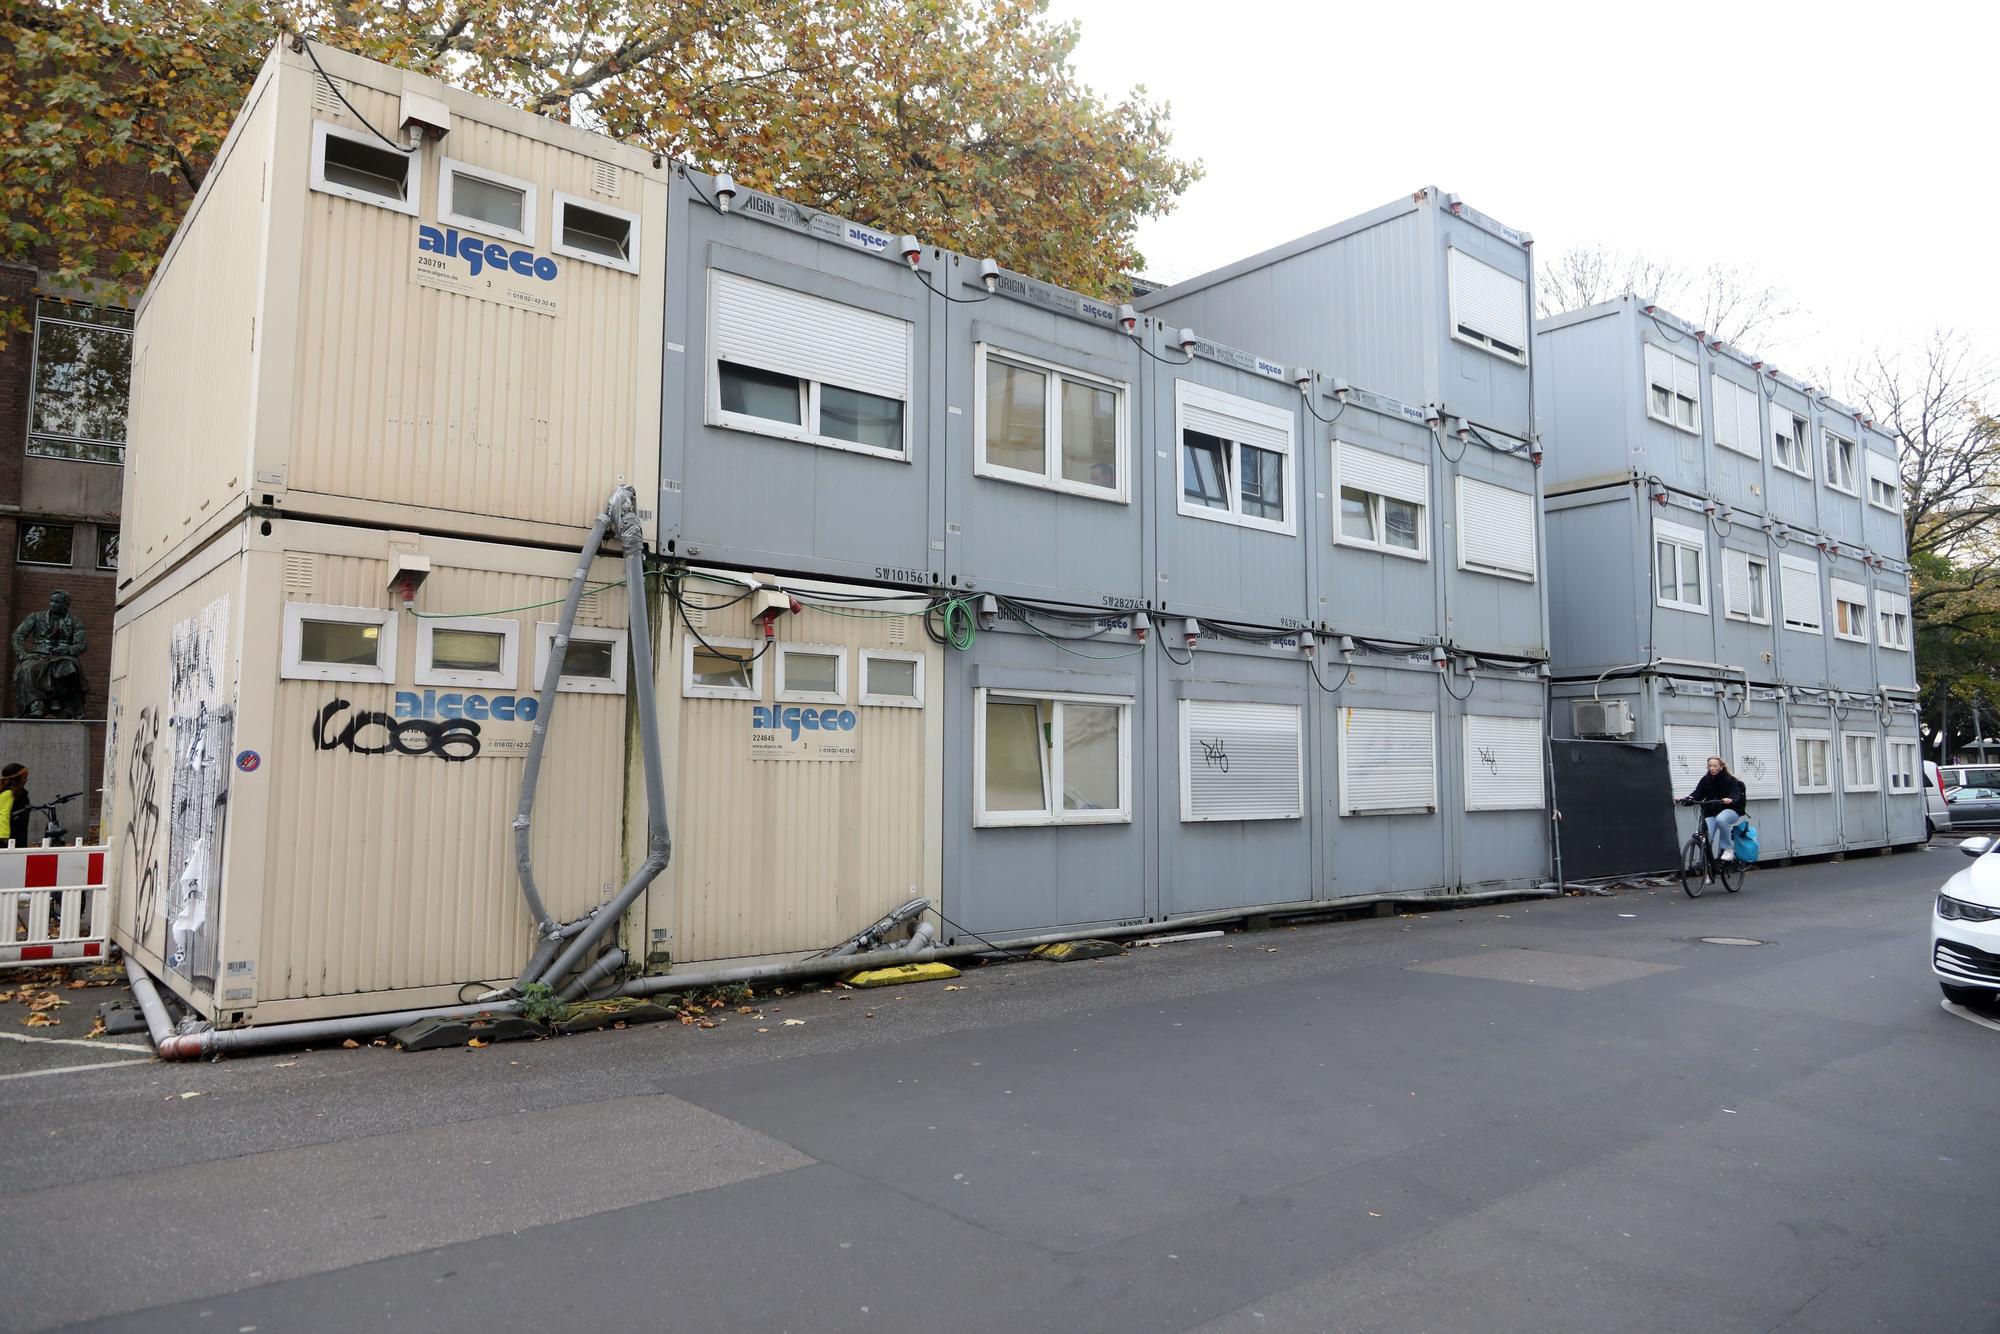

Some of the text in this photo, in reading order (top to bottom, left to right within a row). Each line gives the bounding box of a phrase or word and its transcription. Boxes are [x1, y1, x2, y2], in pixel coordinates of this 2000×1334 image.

[419, 225, 557, 281] algeco
[418, 256, 446, 270] 230791
[417, 267, 458, 280] www.algeco.de
[486, 280, 492, 288] 3
[998, 276, 1026, 295] ORIGIN
[1083, 303, 1113, 319] algeco
[875, 567, 929, 585] SW101561
[395, 690, 540, 734] algeco
[753, 704, 856, 742] algeco
[752, 734, 775, 742] 224645
[803, 742, 808, 750] 3
